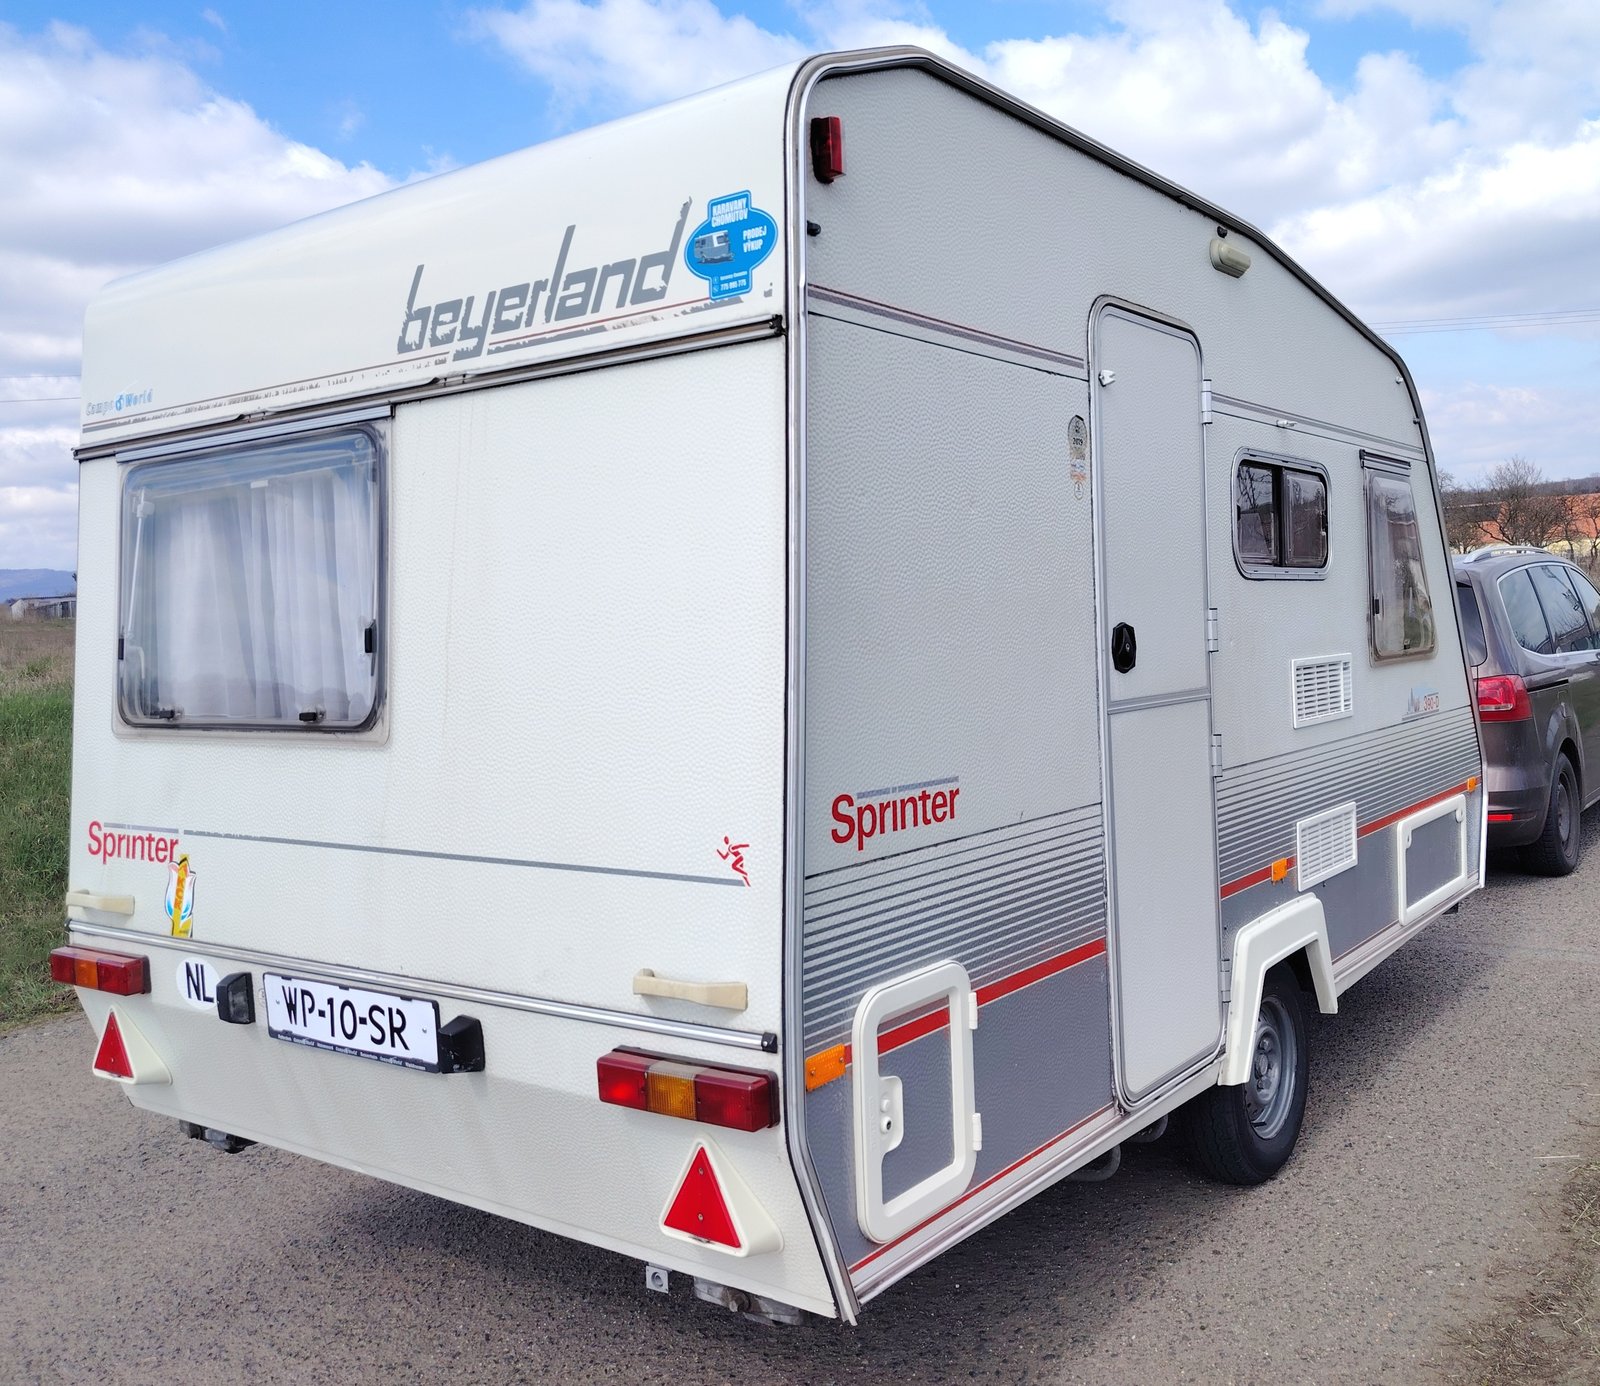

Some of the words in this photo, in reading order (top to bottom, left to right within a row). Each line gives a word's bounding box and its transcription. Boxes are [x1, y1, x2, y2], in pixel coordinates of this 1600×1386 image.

[711, 197, 748, 217] KARAVANY
[711, 207, 749, 228] CHOMUTOV
[742, 225, 767, 241] PRODEJ
[397, 196, 692, 361] beyerland
[831, 788, 960, 852] Sprinter
[88, 821, 179, 865] Sprinter
[185, 961, 215, 1004] NL
[281, 984, 411, 1051] WP-10-SR
